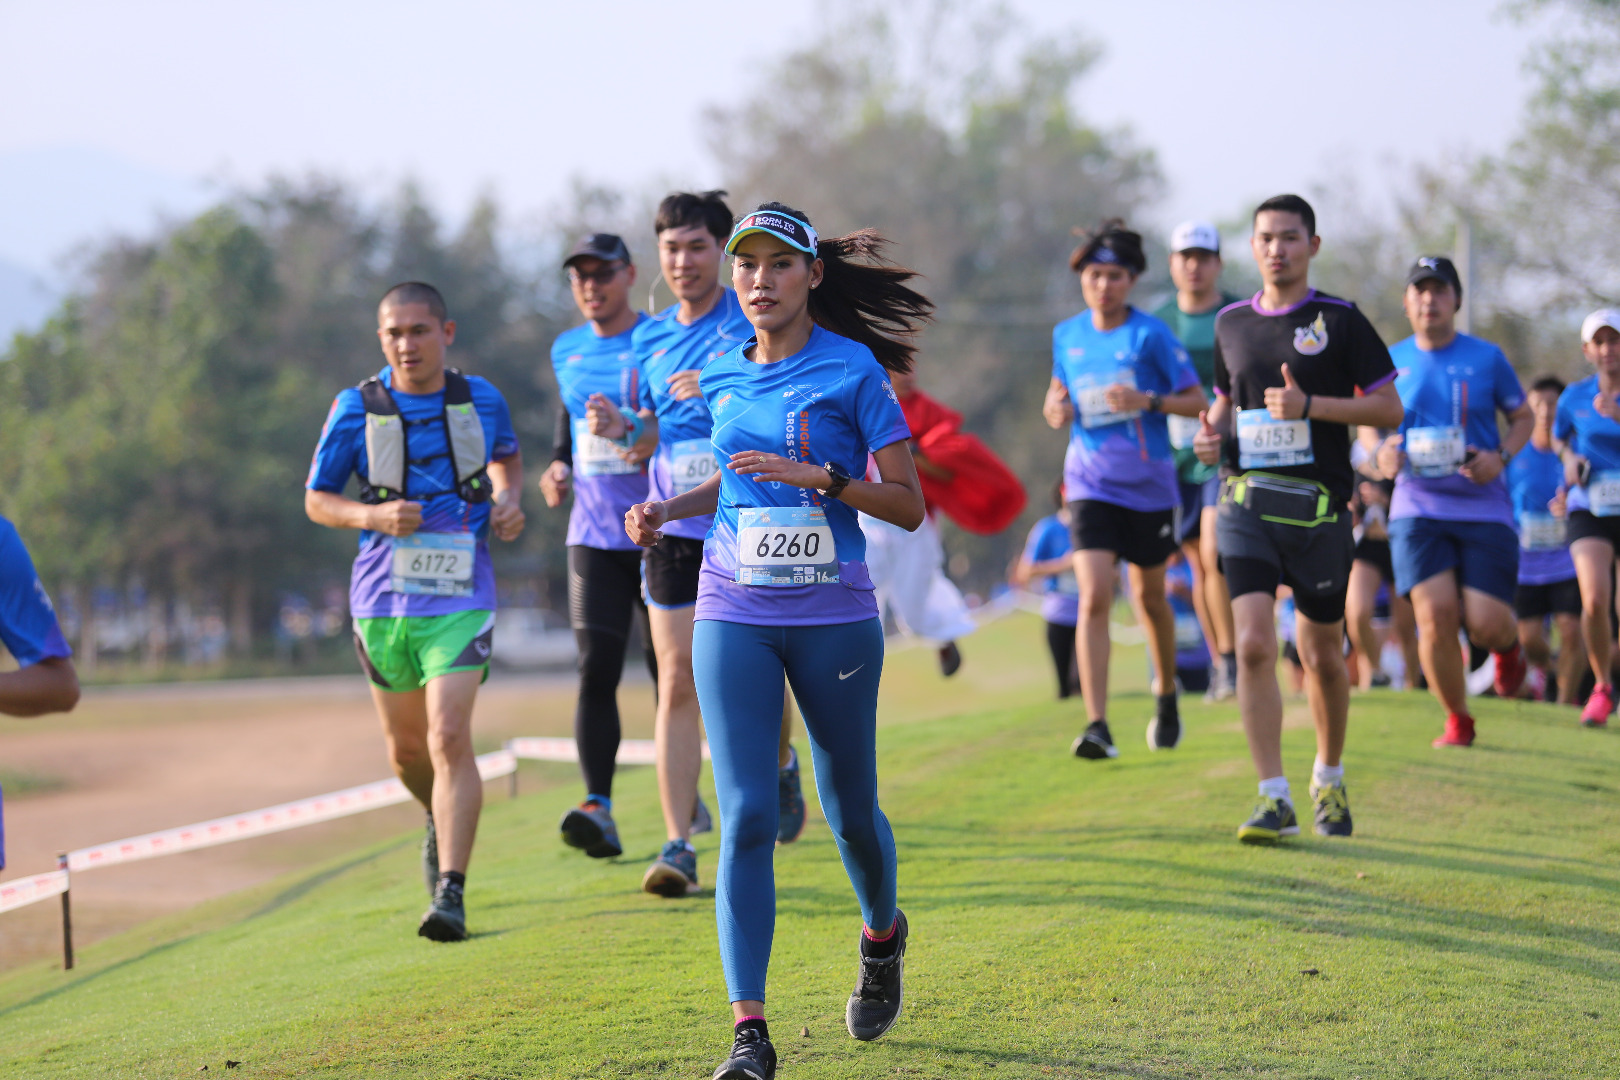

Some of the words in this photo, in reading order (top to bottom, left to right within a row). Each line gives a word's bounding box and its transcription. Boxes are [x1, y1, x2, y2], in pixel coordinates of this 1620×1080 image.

[755, 217, 782, 225] BORN
[783, 220, 795, 230] TO
[785, 411, 795, 447] CROSS
[800, 410, 810, 458] SINGHA
[1253, 426, 1295, 448] 6153
[756, 532, 820, 557] 6260
[410, 552, 458, 574] 6172
